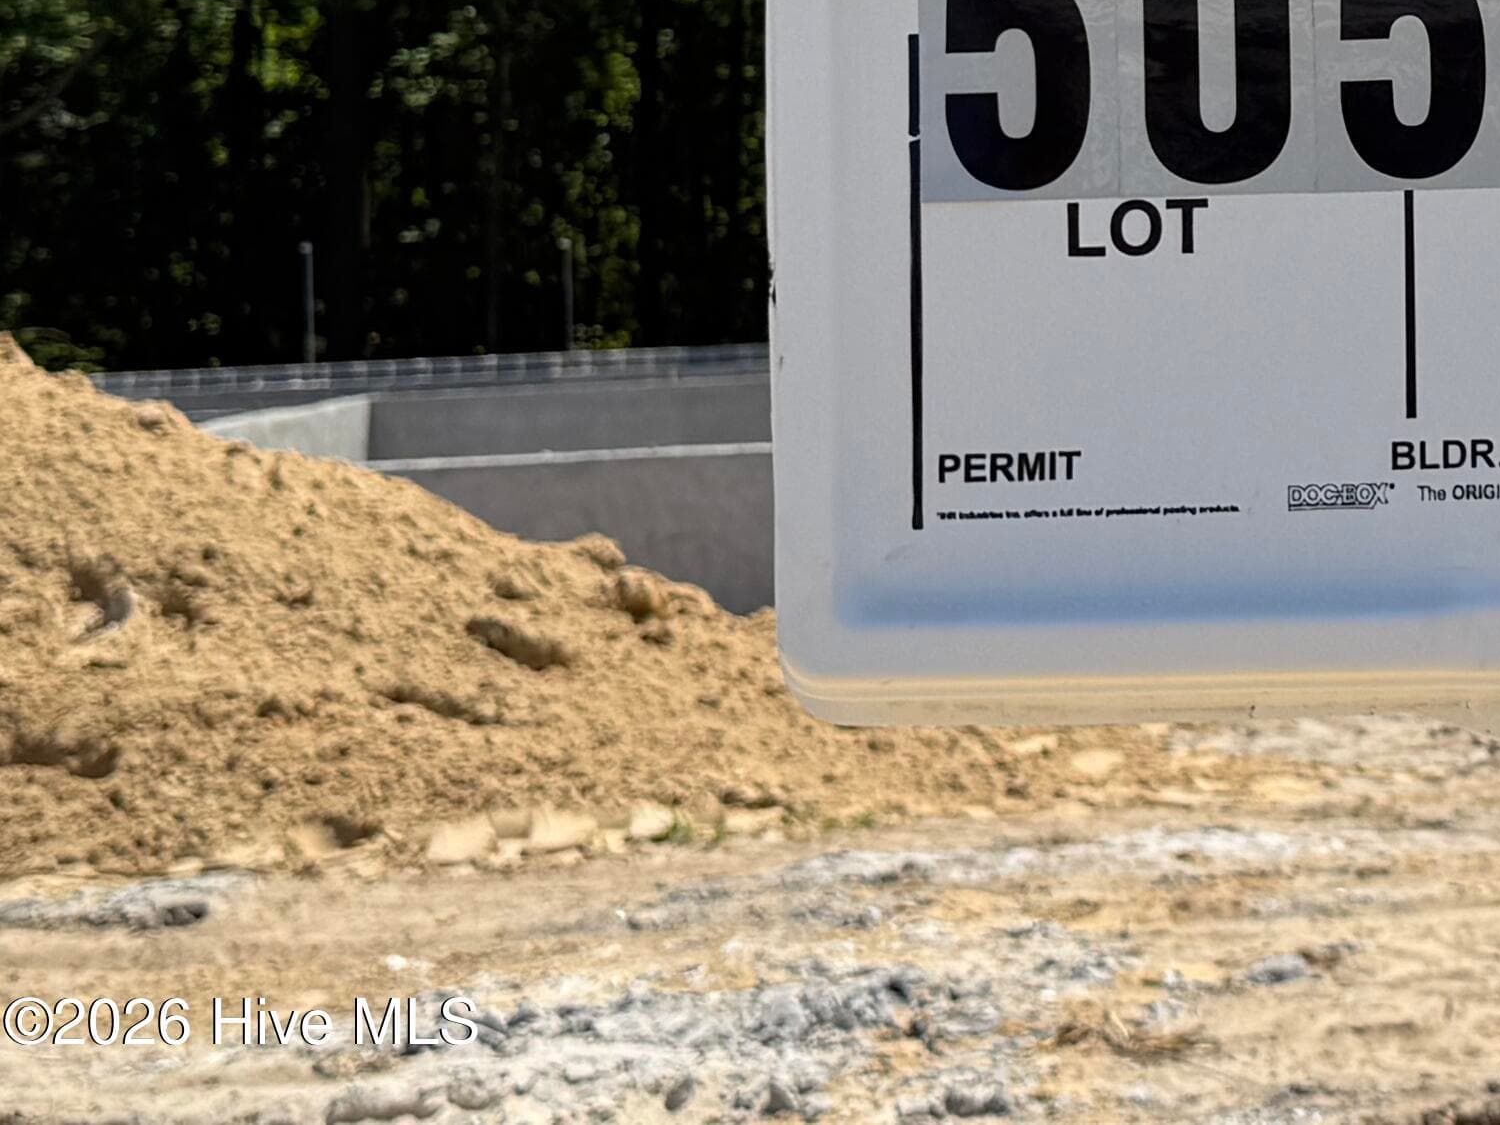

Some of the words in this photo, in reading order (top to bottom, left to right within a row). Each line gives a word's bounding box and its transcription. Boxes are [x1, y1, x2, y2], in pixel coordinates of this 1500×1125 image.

[1066, 198, 1209, 257] LOT
[937, 450, 1082, 484] PERMIT
[1416, 484, 1447, 502] The
